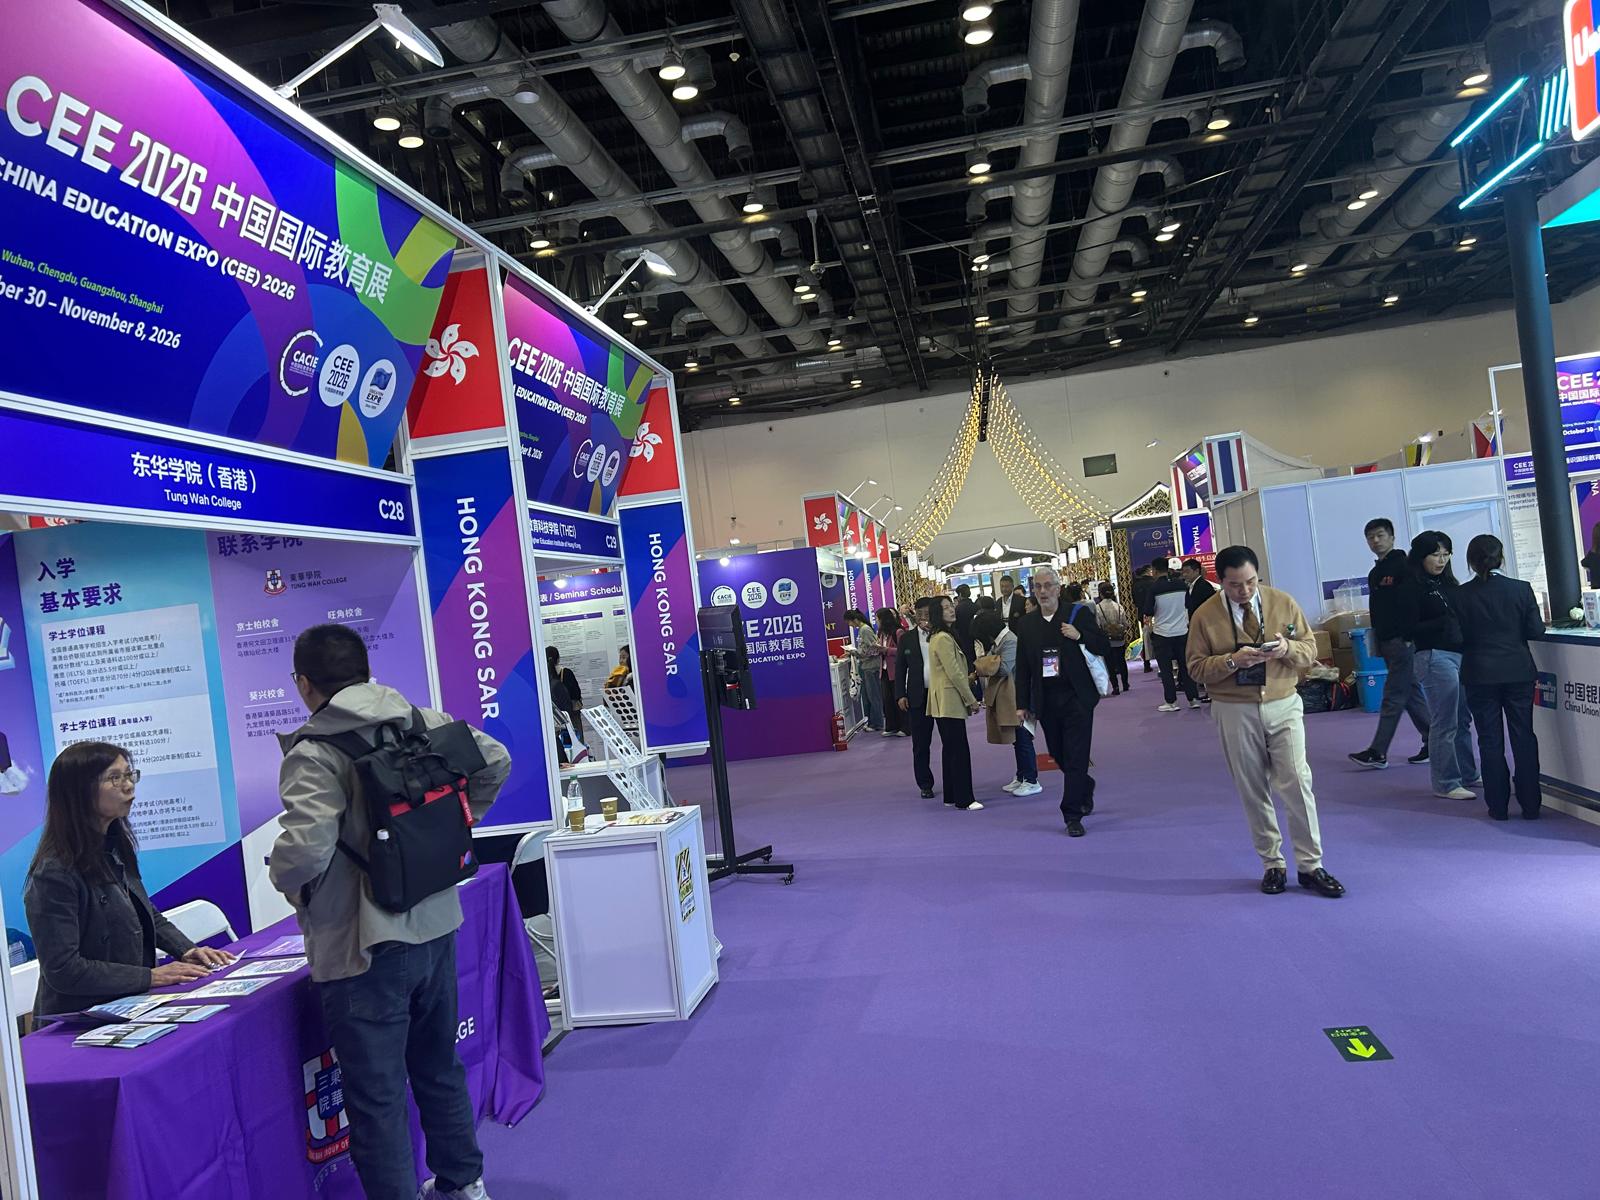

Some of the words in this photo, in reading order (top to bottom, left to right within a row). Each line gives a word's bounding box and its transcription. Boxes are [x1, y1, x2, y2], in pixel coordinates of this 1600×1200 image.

[6, 75, 123, 174] CEE
[119, 133, 207, 215] 2026
[211, 181, 393, 305] 中国国际教育展
[62, 186, 174, 249] EDUCATION
[174, 235, 218, 268] EXPO
[220, 254, 260, 288] (CEE)
[261, 270, 296, 300] 2026
[2, 249, 36, 271] Wuhan,
[37, 262, 78, 286] Chengdu,
[80, 277, 127, 302] Guangzhou,
[128, 293, 164, 314] Shanghai
[24, 286, 47, 308] 30
[59, 296, 135, 335] November
[134, 322, 147, 341] 8,
[148, 326, 182, 349] 2026
[293, 350, 319, 369] CACIE
[333, 355, 354, 374] CEE
[326, 369, 350, 390] 2026
[508, 337, 541, 377] CEE
[535, 352, 565, 390] 2026
[563, 366, 626, 419] 中国国际教育展
[1557, 372, 1594, 390] CEE
[366, 393, 382, 404] EXPO
[516, 388, 548, 408] EDUCATION
[547, 398, 562, 415] EXPO
[575, 412, 587, 425] 2026
[1562, 428, 1585, 436] October
[131, 452, 257, 493] 东华学院（香港）
[164, 489, 188, 505] Tung
[189, 491, 210, 506] Wah
[210, 495, 242, 510] College
[378, 499, 405, 521] C28
[457, 497, 483, 574] HONG
[606, 535, 617, 549] C29
[649, 533, 667, 583] HONG
[37, 558, 76, 582] 入学
[848, 570, 856, 591] HONG
[290, 582, 306, 590] TUNG
[307, 580, 321, 588] WAH
[321, 576, 347, 586] COLLEGE
[40, 582, 122, 614] 基本要求
[554, 590, 588, 600] Seminar
[747, 592, 762, 602] 2026
[327, 607, 363, 620] 旺角校舍
[466, 582, 493, 659] KONG
[655, 587, 674, 637] KONG
[48, 624, 106, 641] 学士学位课程
[236, 618, 279, 632] 京士柏校舍
[763, 614, 803, 636] 2026
[663, 642, 678, 676] SAR
[786, 652, 806, 660] EXPO
[477, 667, 500, 720] SAR
[1564, 681, 1600, 704] 中国银
[1564, 701, 1581, 713] China
[1582, 703, 1600, 716] Union
[59, 716, 117, 733] 学士学位课程
[455, 1016, 475, 1044] GE
